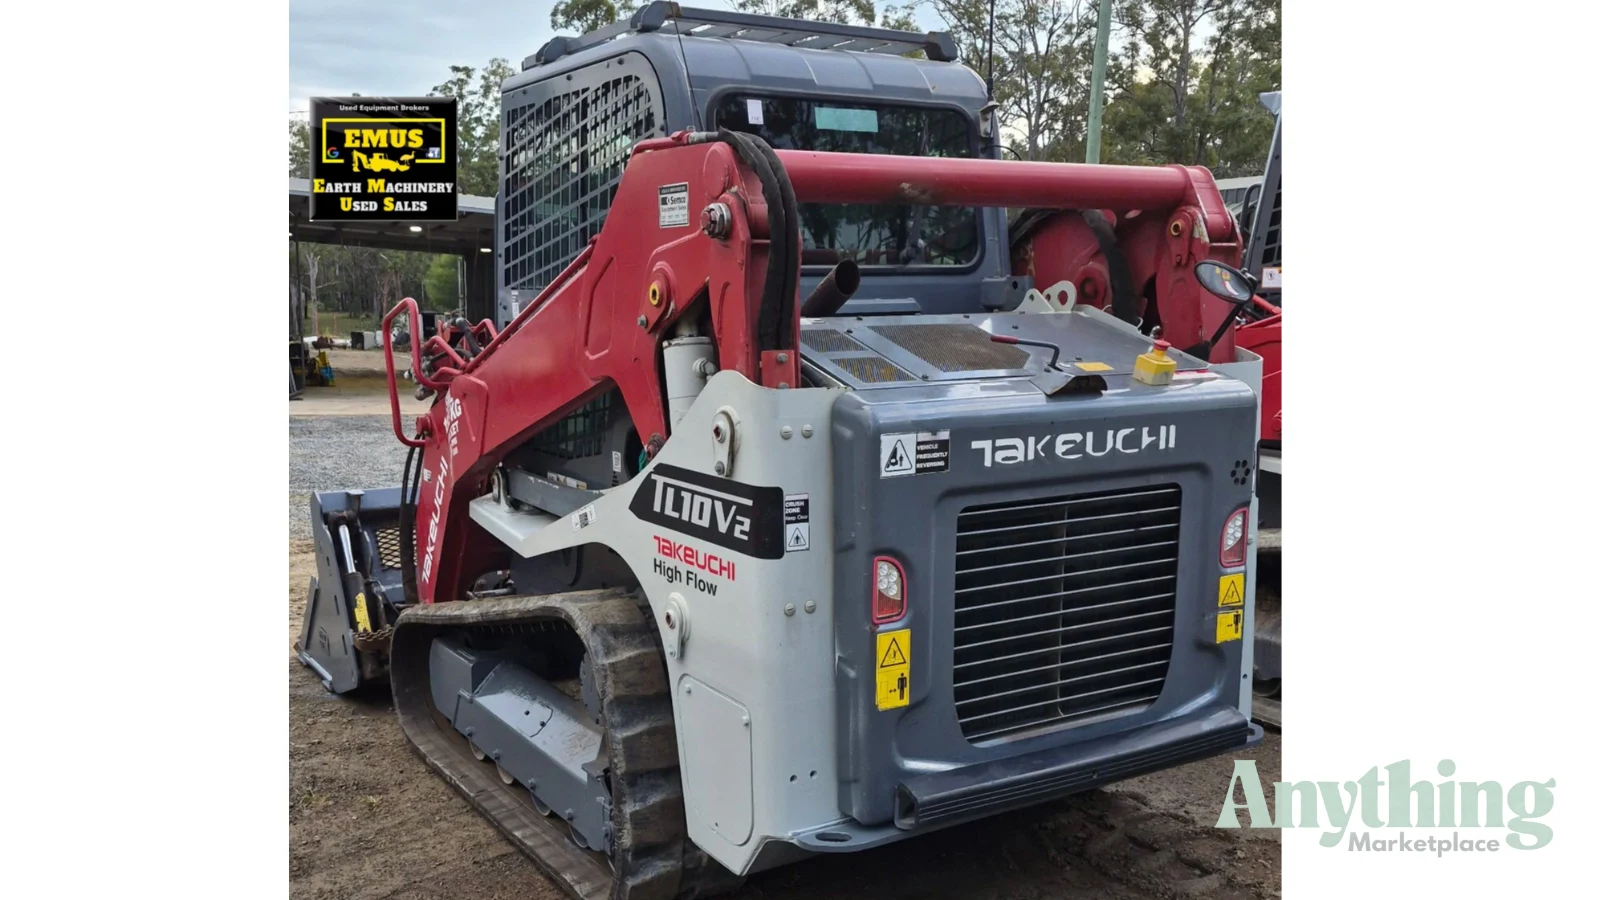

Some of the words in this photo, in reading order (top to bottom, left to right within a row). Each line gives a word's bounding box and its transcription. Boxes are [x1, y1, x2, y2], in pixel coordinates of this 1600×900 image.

[916, 443, 939, 451] VEHICLE
[916, 451, 948, 460] FREQUENTLY
[916, 460, 945, 469] REVERSING
[651, 473, 754, 541] TL10V2
[653, 558, 682, 583] High
[686, 570, 718, 596] Flow
